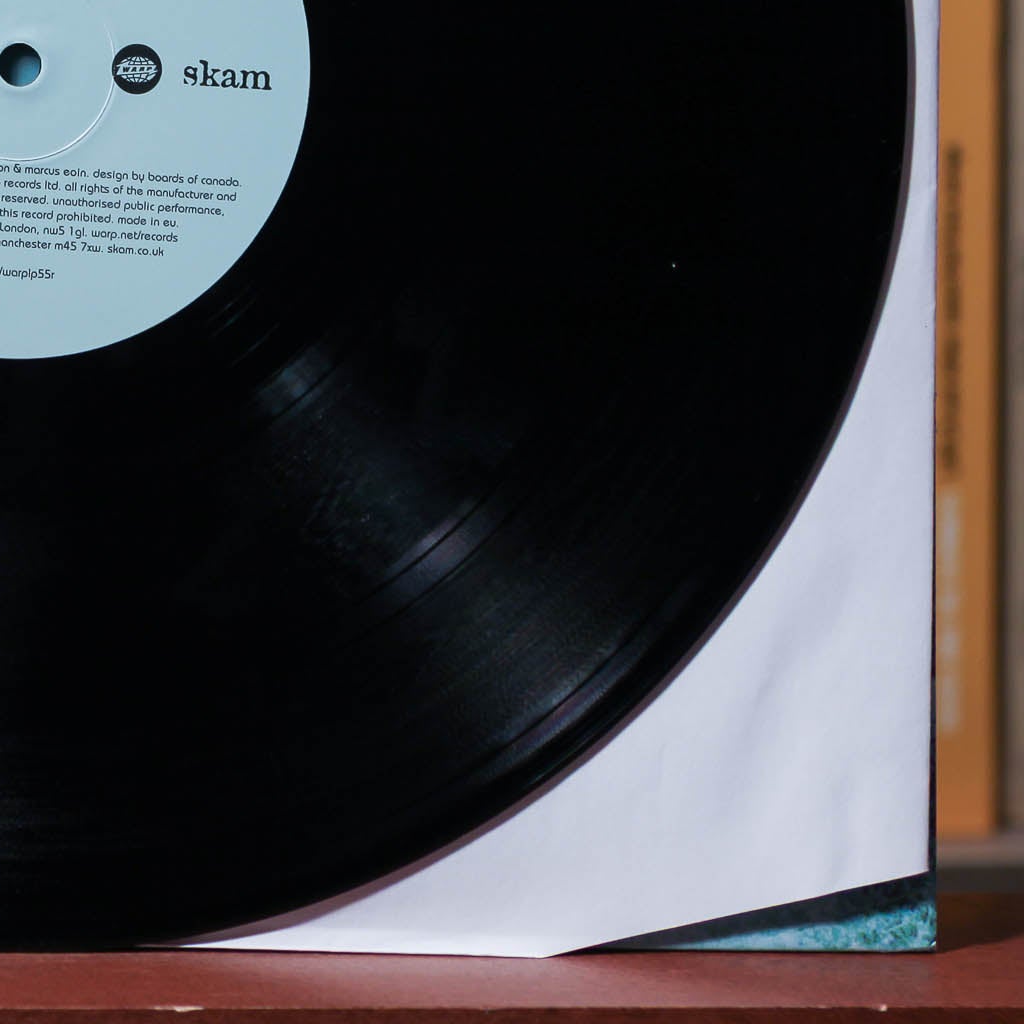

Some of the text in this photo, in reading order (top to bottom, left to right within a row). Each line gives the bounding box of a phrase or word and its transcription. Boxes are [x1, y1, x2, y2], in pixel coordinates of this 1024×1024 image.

[183, 59, 272, 91] skam
[13, 163, 22, 174] &
[24, 167, 60, 176] marcus
[63, 167, 90, 178] eoin.
[93, 169, 129, 182] design
[131, 171, 145, 184] by
[148, 171, 185, 184] boards
[187, 174, 199, 185] of
[200, 176, 242, 187] canada.
[3, 179, 42, 190] records
[44, 180, 61, 191] ltd.
[64, 182, 78, 192] all
[80, 183, 110, 196] rights
[112, 184, 124, 195] of
[126, 185, 144, 196] the
[146, 188, 214, 201] manufacturer
[216, 191, 237, 202] and
[1, 194, 49, 205] reserved.
[52, 197, 121, 210] unauthorised
[124, 201, 155, 213] public
[157, 204, 225, 217] performance,
[0, 208, 19, 218] this
[21, 210, 54, 220] record
[56, 212, 114, 224] prohibited.
[117, 215, 148, 226] made
[150, 216, 160, 227] in
[163, 219, 179, 228] eu.
[42, 225, 66, 236] nw5
[54, 240, 77, 251] m45
[107, 245, 165, 257] skam.co.uk
